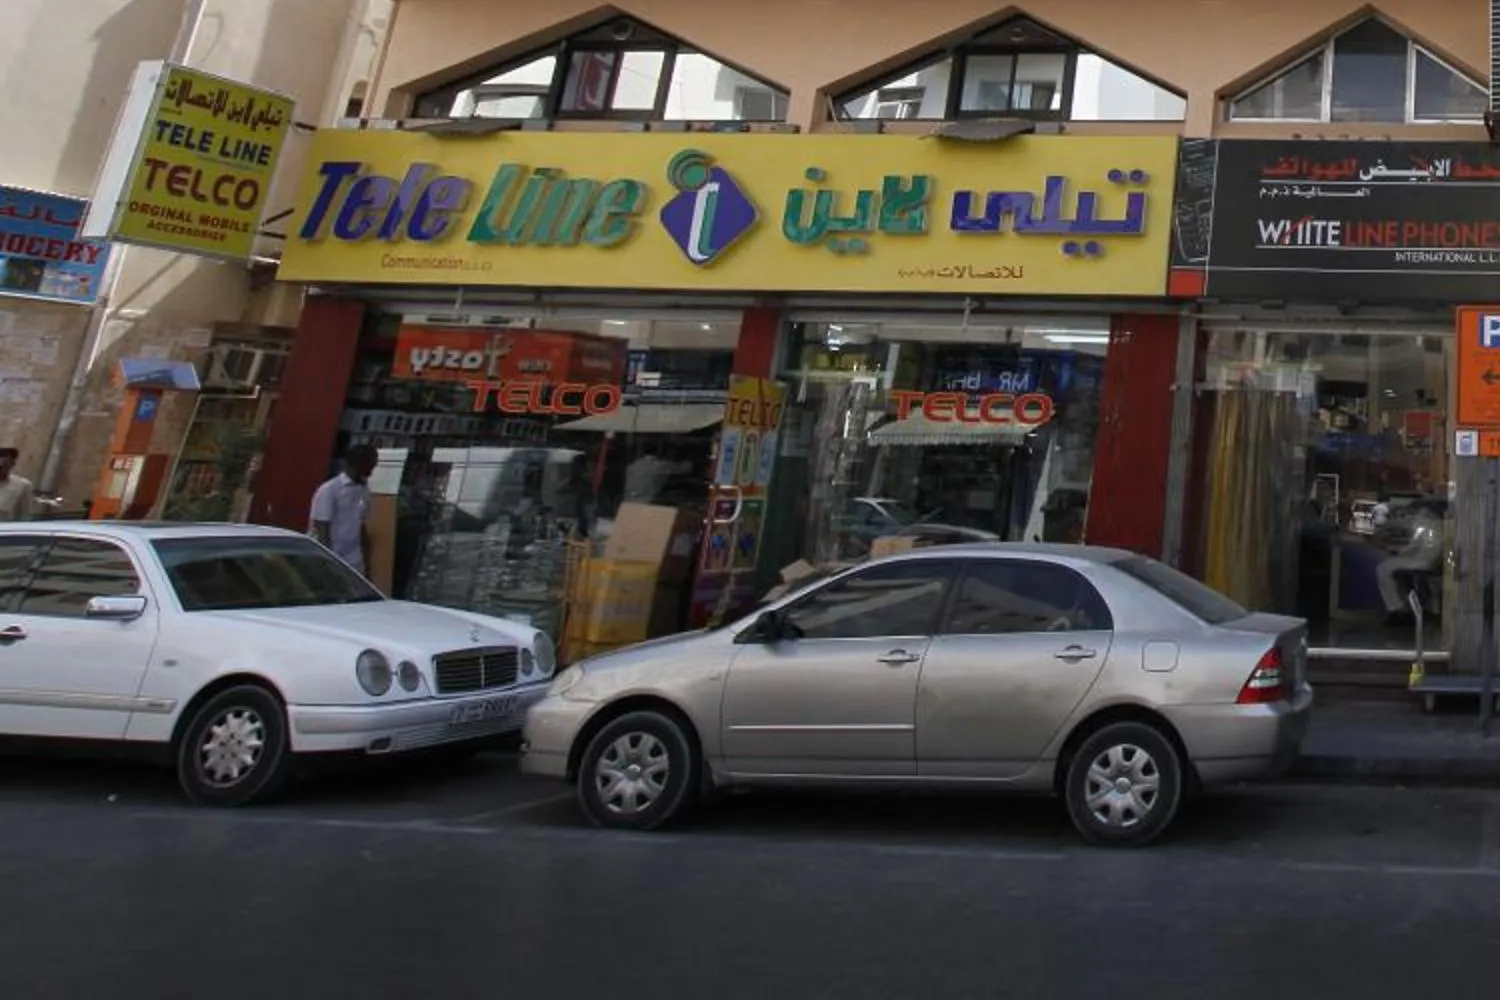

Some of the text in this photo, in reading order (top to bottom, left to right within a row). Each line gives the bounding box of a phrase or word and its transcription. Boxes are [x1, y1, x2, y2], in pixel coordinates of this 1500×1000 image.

[155, 118, 273, 166] TELE LINE
[143, 157, 260, 211] TELCO
[299, 161, 650, 248] Tele Line
[782, 166, 932, 256] لاين
[0, 232, 104, 266] OCERY
[1257, 217, 1341, 246] WHITE
[1344, 221, 1397, 247] LINE
[1394, 250, 1477, 263] INTERNATIONAL
[466, 377, 623, 416] TELCO
[892, 389, 1056, 426] TELCO
